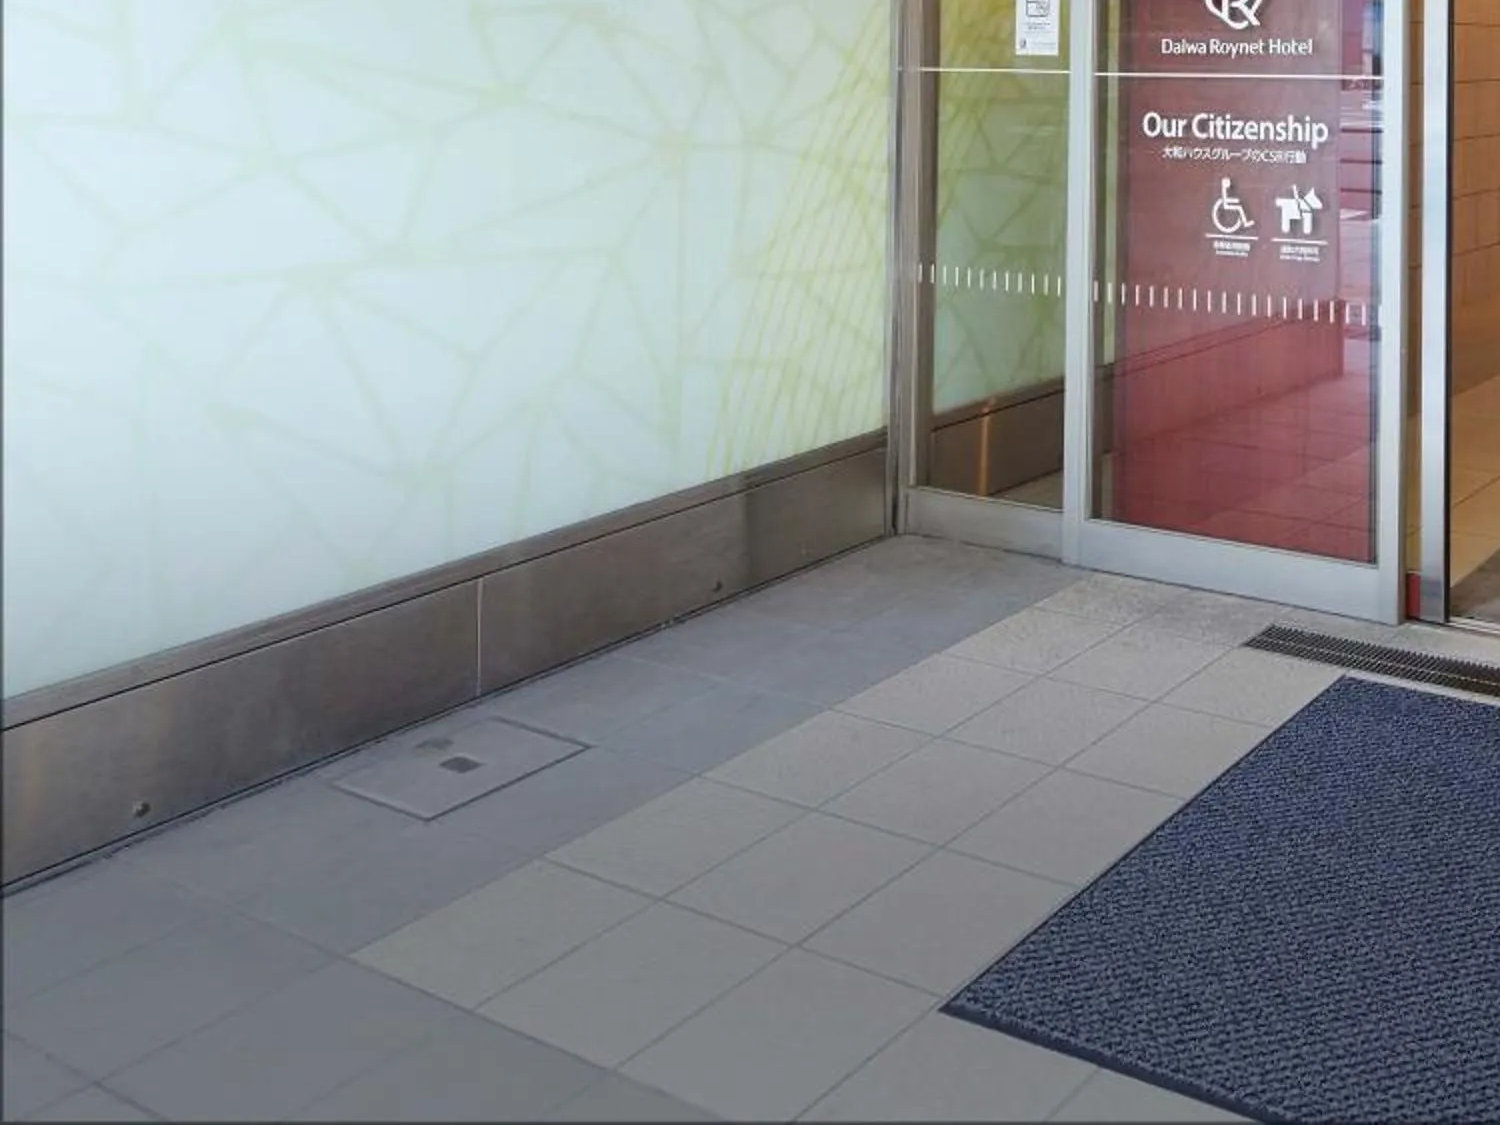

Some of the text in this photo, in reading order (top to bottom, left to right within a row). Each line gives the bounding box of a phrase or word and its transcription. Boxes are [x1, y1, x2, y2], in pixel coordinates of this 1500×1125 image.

[1160, 37, 1314, 59] Daiwa Roynet Hotel
[1142, 111, 1330, 150] Our Citizenship
